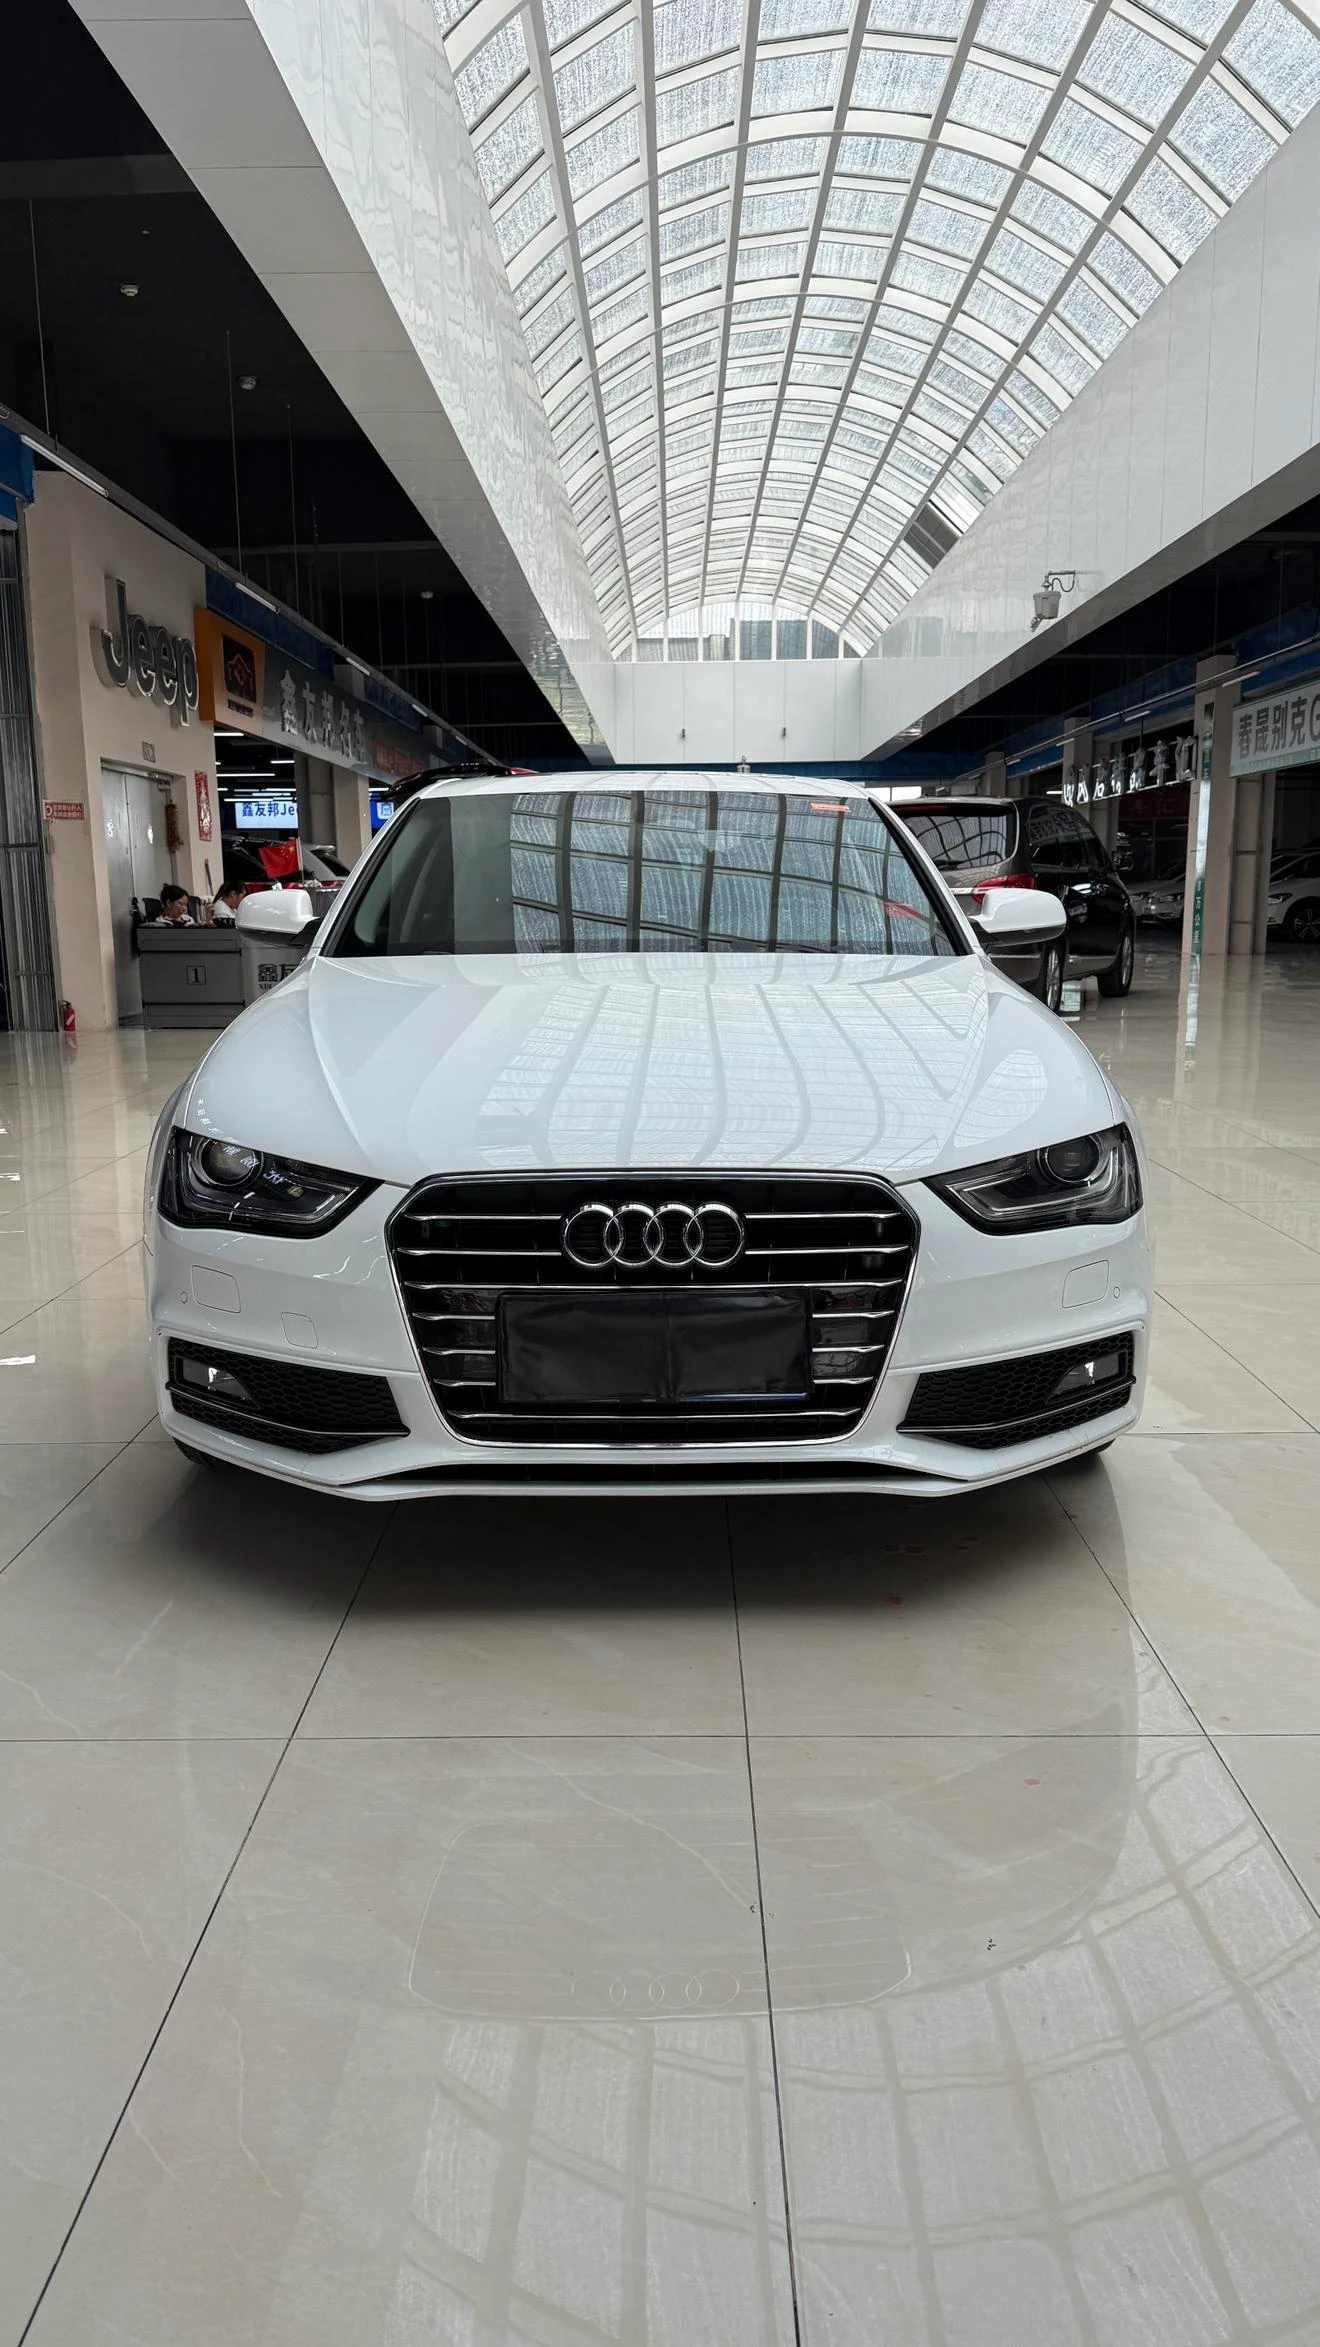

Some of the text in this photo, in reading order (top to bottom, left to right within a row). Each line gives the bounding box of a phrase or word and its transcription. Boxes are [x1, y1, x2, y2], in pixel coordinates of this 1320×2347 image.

[90, 575, 200, 728] Jeep
[242, 801, 298, 817] 鑫友邦Je
[191, 967, 201, 983] 1
